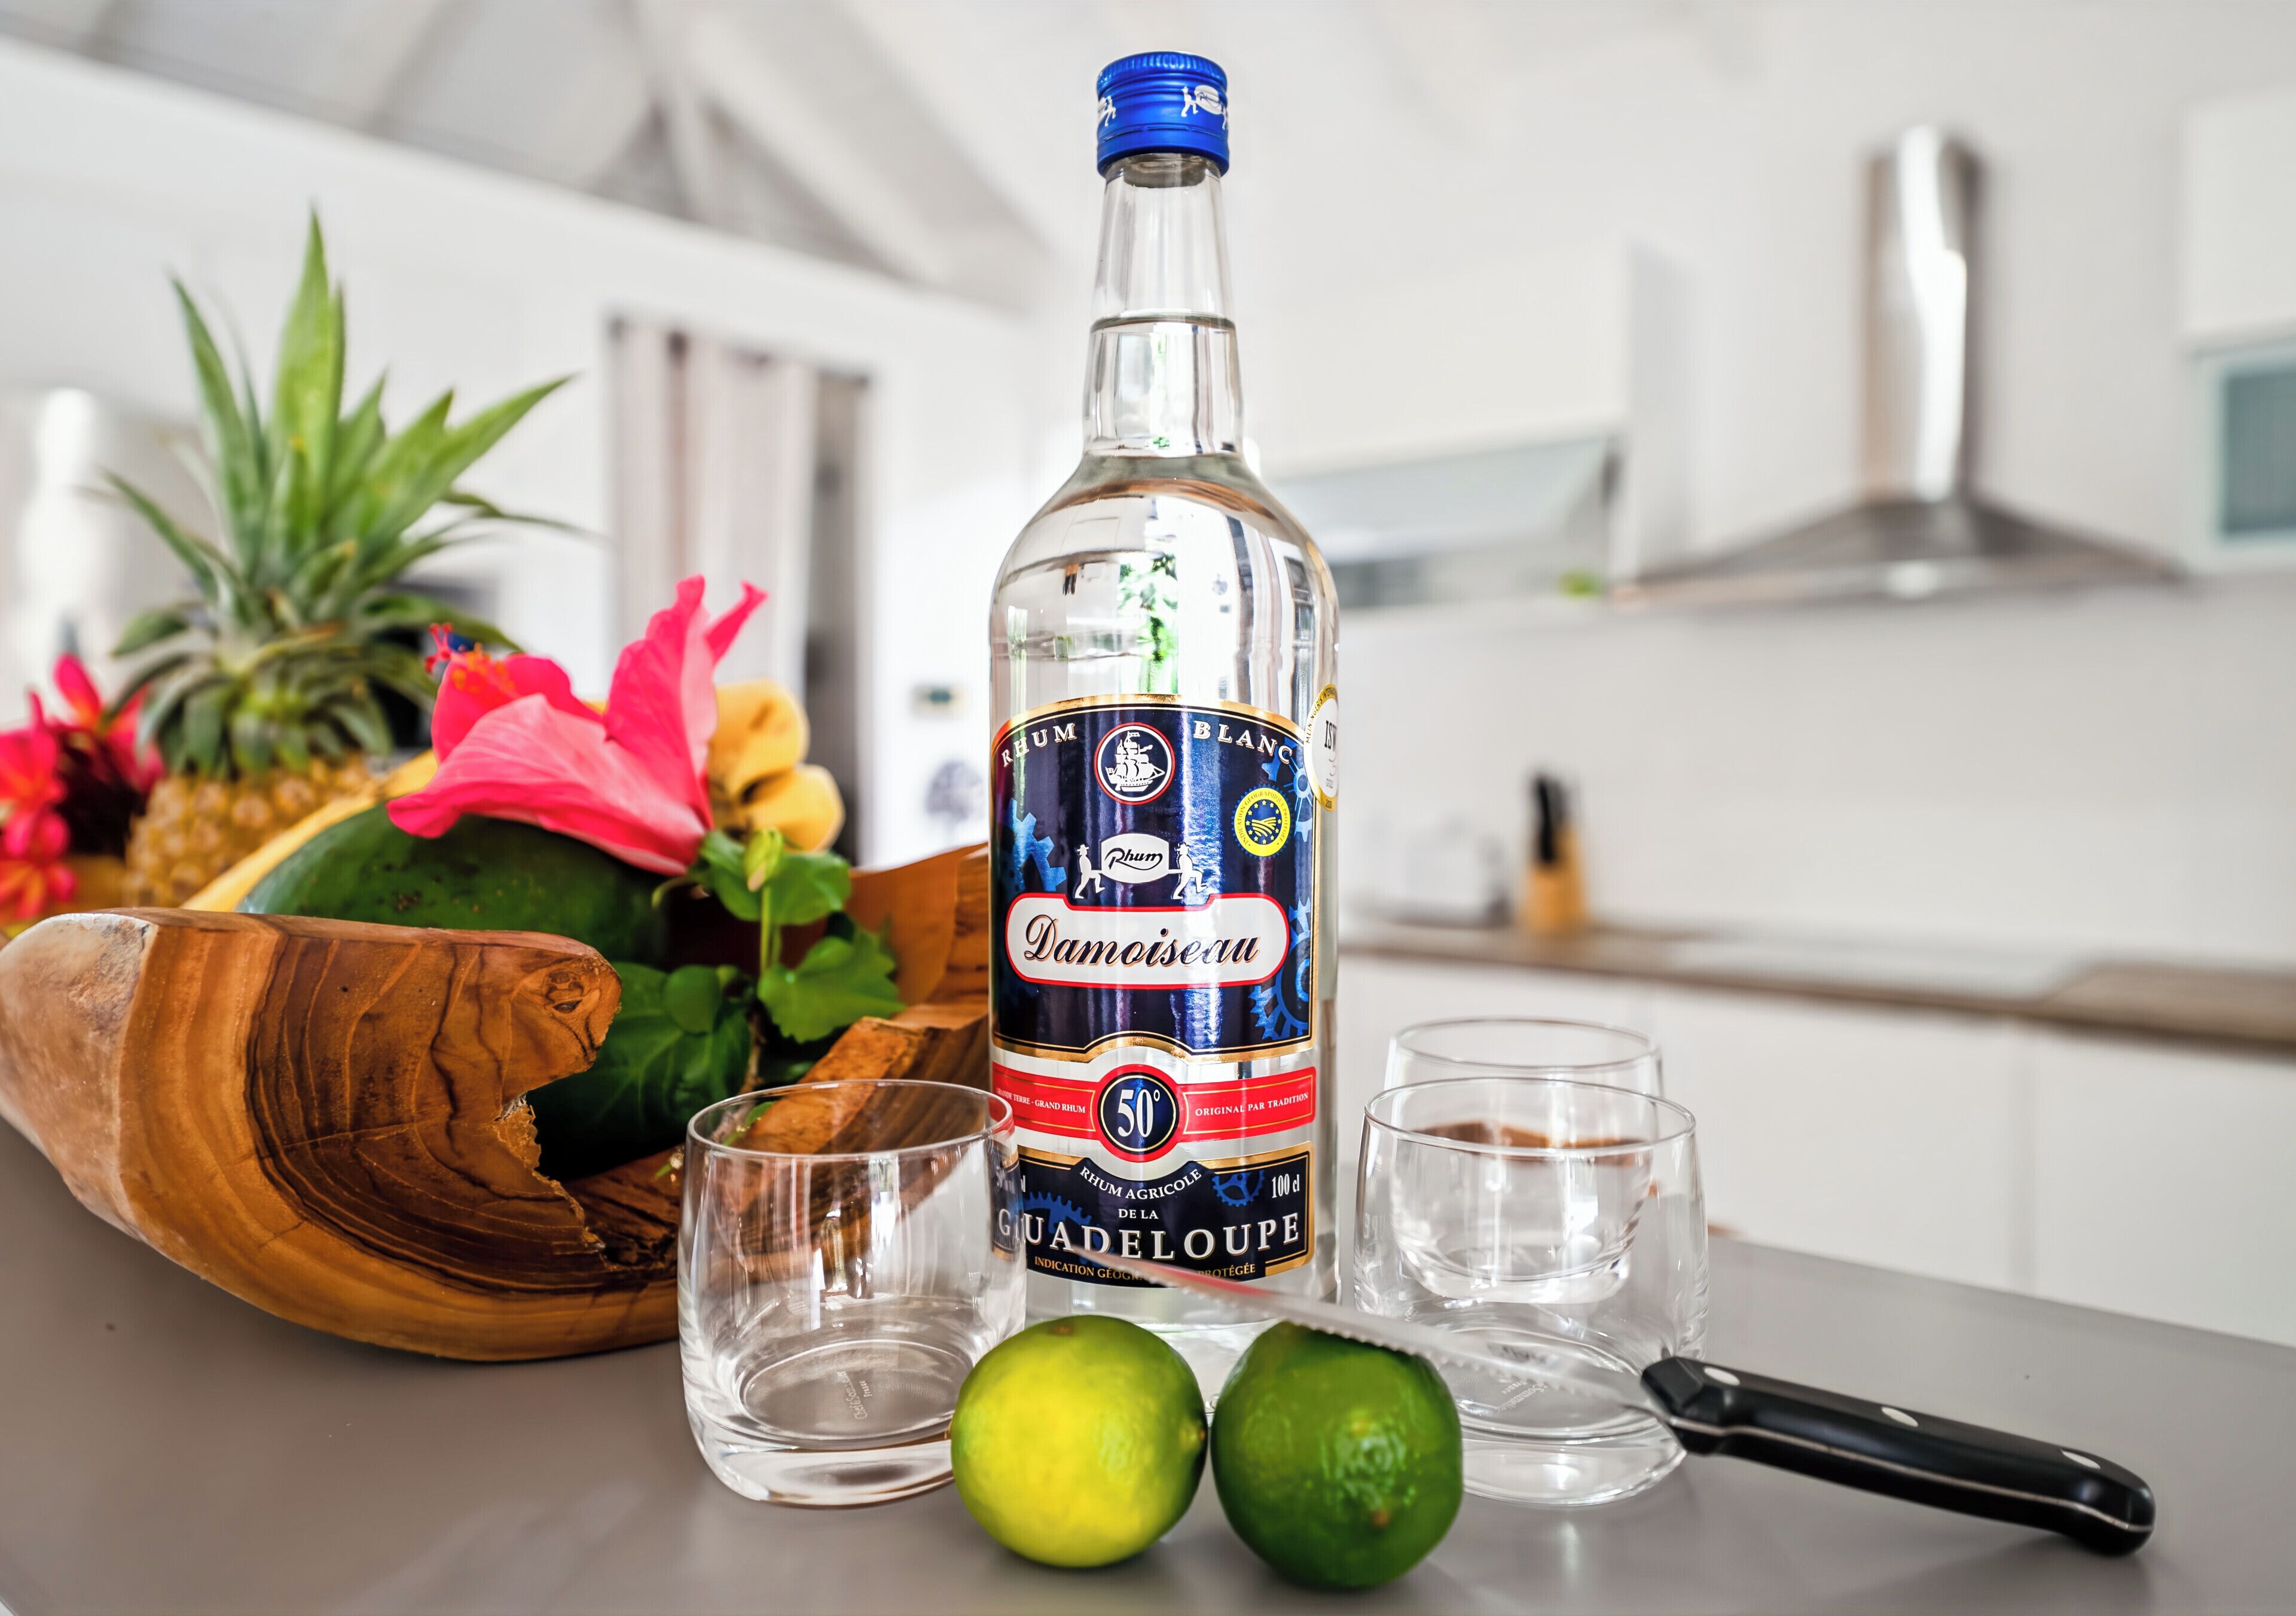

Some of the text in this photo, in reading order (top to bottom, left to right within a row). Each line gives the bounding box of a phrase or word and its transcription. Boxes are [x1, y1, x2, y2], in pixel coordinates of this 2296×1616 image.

[1002, 720, 1293, 768] RHUM BLANC
[1104, 847, 1163, 870] Rhum
[1024, 914, 1261, 969] Damoiseau
[1013, 1093, 1030, 1105] TERRE
[1034, 1099, 1060, 1110] GRAND
[1061, 1104, 1086, 1114] RHUM
[1117, 1089, 1160, 1137] 50°
[1195, 1092, 1308, 1116] ORIGINAL PAR TRADITION
[1079, 1166, 1202, 1199] RHUM AGRICOLE
[1272, 1174, 1300, 1198] 100 cl
[1118, 1208, 1159, 1219] DE LA
[1034, 1256, 1094, 1276] INDICATION
